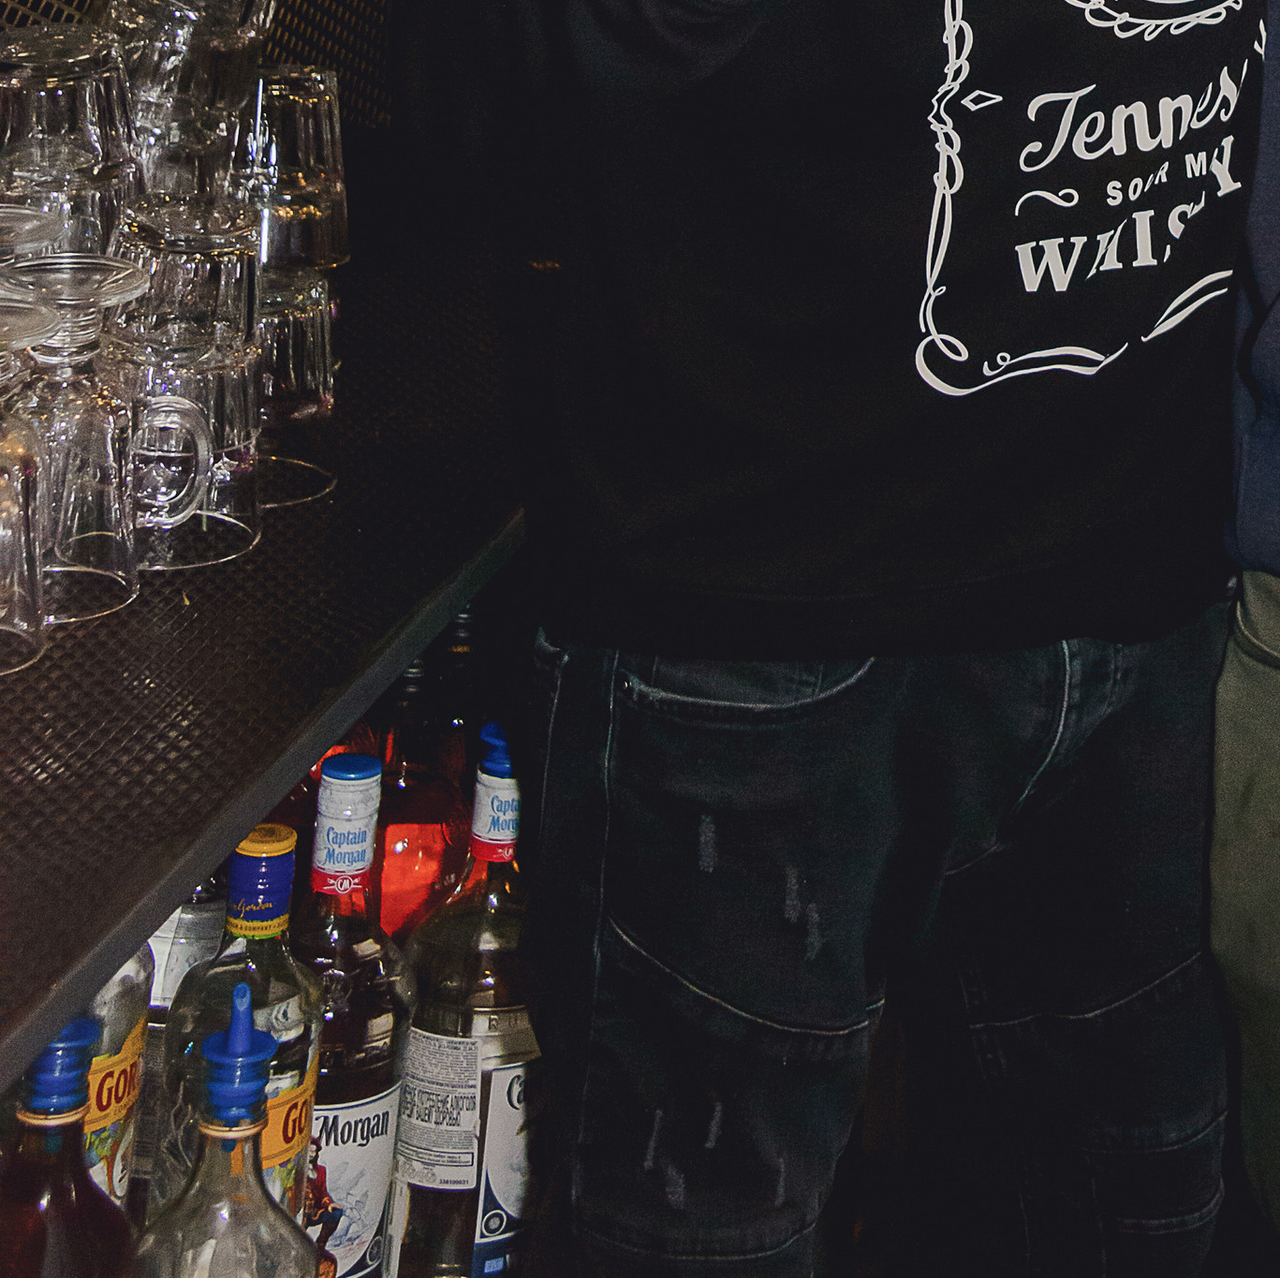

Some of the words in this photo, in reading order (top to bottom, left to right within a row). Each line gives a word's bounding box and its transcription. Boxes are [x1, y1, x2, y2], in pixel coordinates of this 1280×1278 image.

[327, 826, 367, 848] Captain
[324, 846, 366, 867] Morgan
[316, 1109, 390, 1147] Morgan
